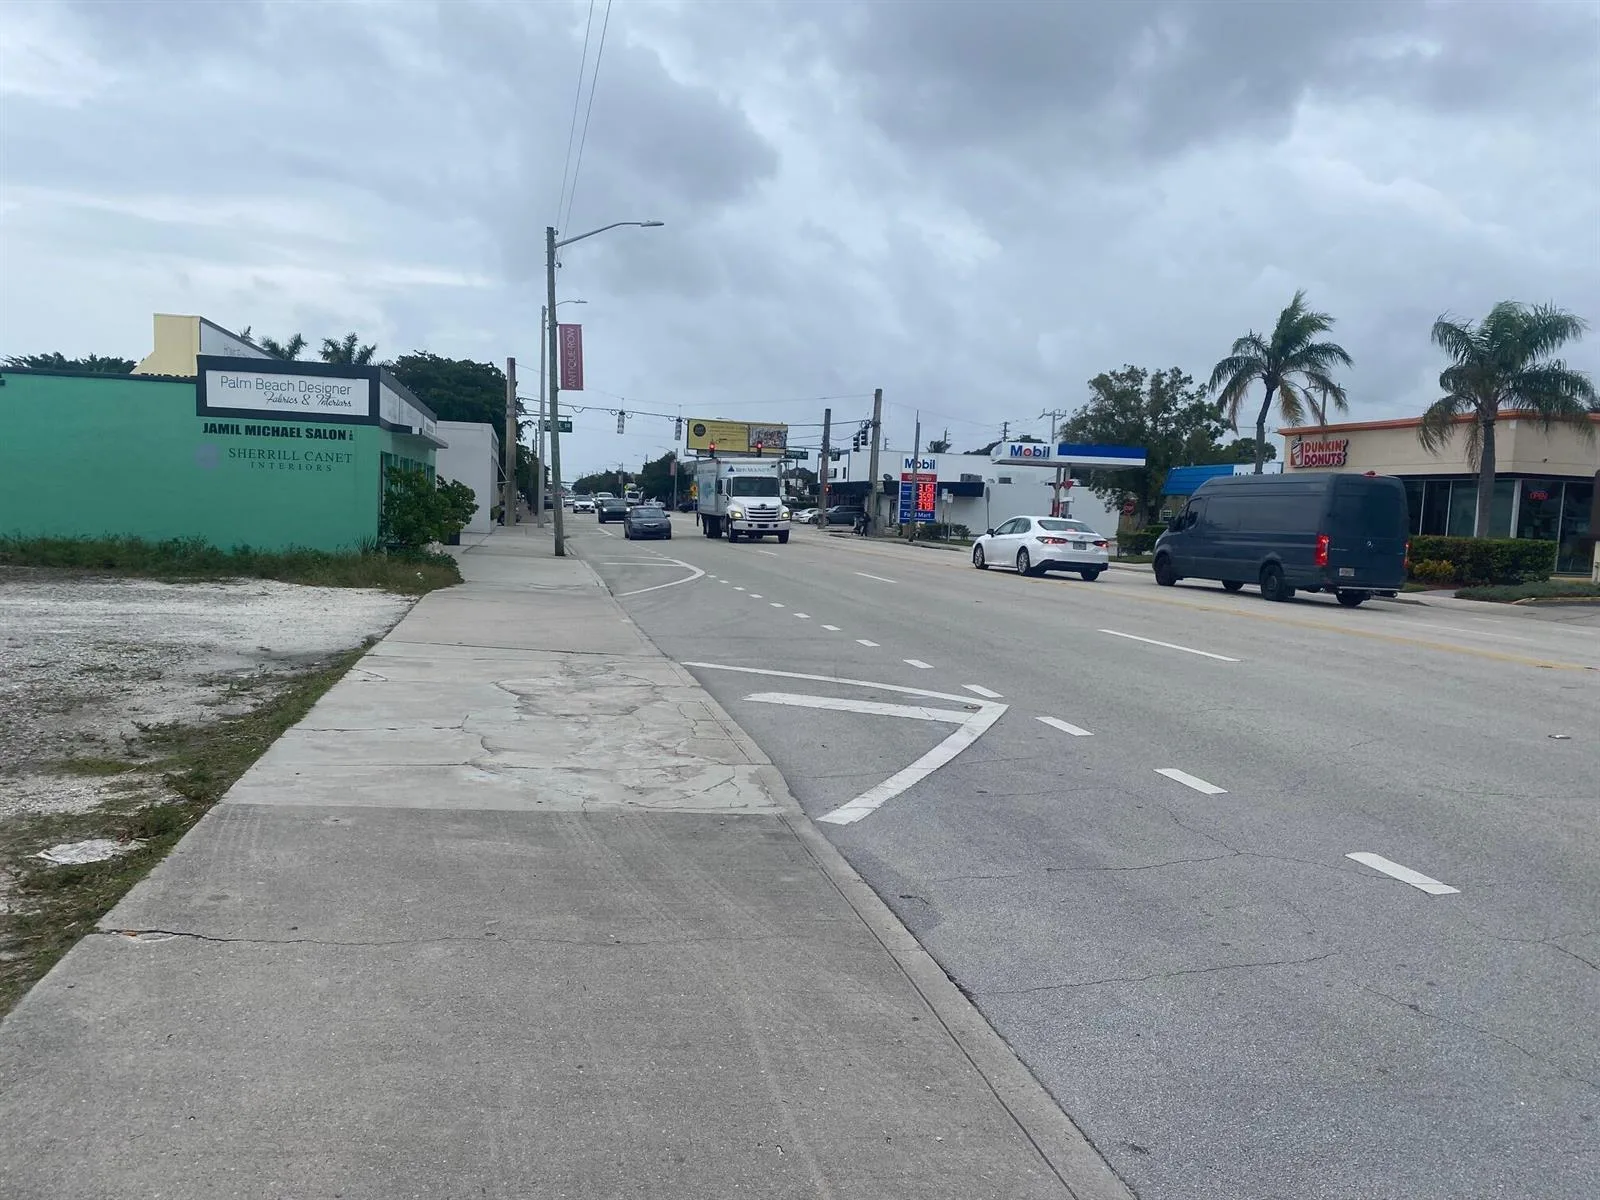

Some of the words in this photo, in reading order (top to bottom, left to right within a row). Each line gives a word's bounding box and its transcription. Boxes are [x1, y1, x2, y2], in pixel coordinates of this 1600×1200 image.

[566, 327, 576, 348] ROW
[567, 349, 577, 388] ANTIQUE
[220, 376, 252, 389] Palm
[255, 378, 295, 392] Beach
[299, 380, 352, 398] Designer
[264, 391, 298, 406] Fabrics
[302, 394, 311, 406] &
[203, 422, 242, 436] JAMIL
[245, 424, 302, 438] MICHAEL
[305, 427, 346, 441] SALON
[228, 447, 300, 461] SHERRILL
[304, 451, 353, 464] CANET
[1010, 444, 1051, 458] Mobil
[1304, 452, 1343, 466] DONUTS
[251, 461, 332, 472] INTERIORS
